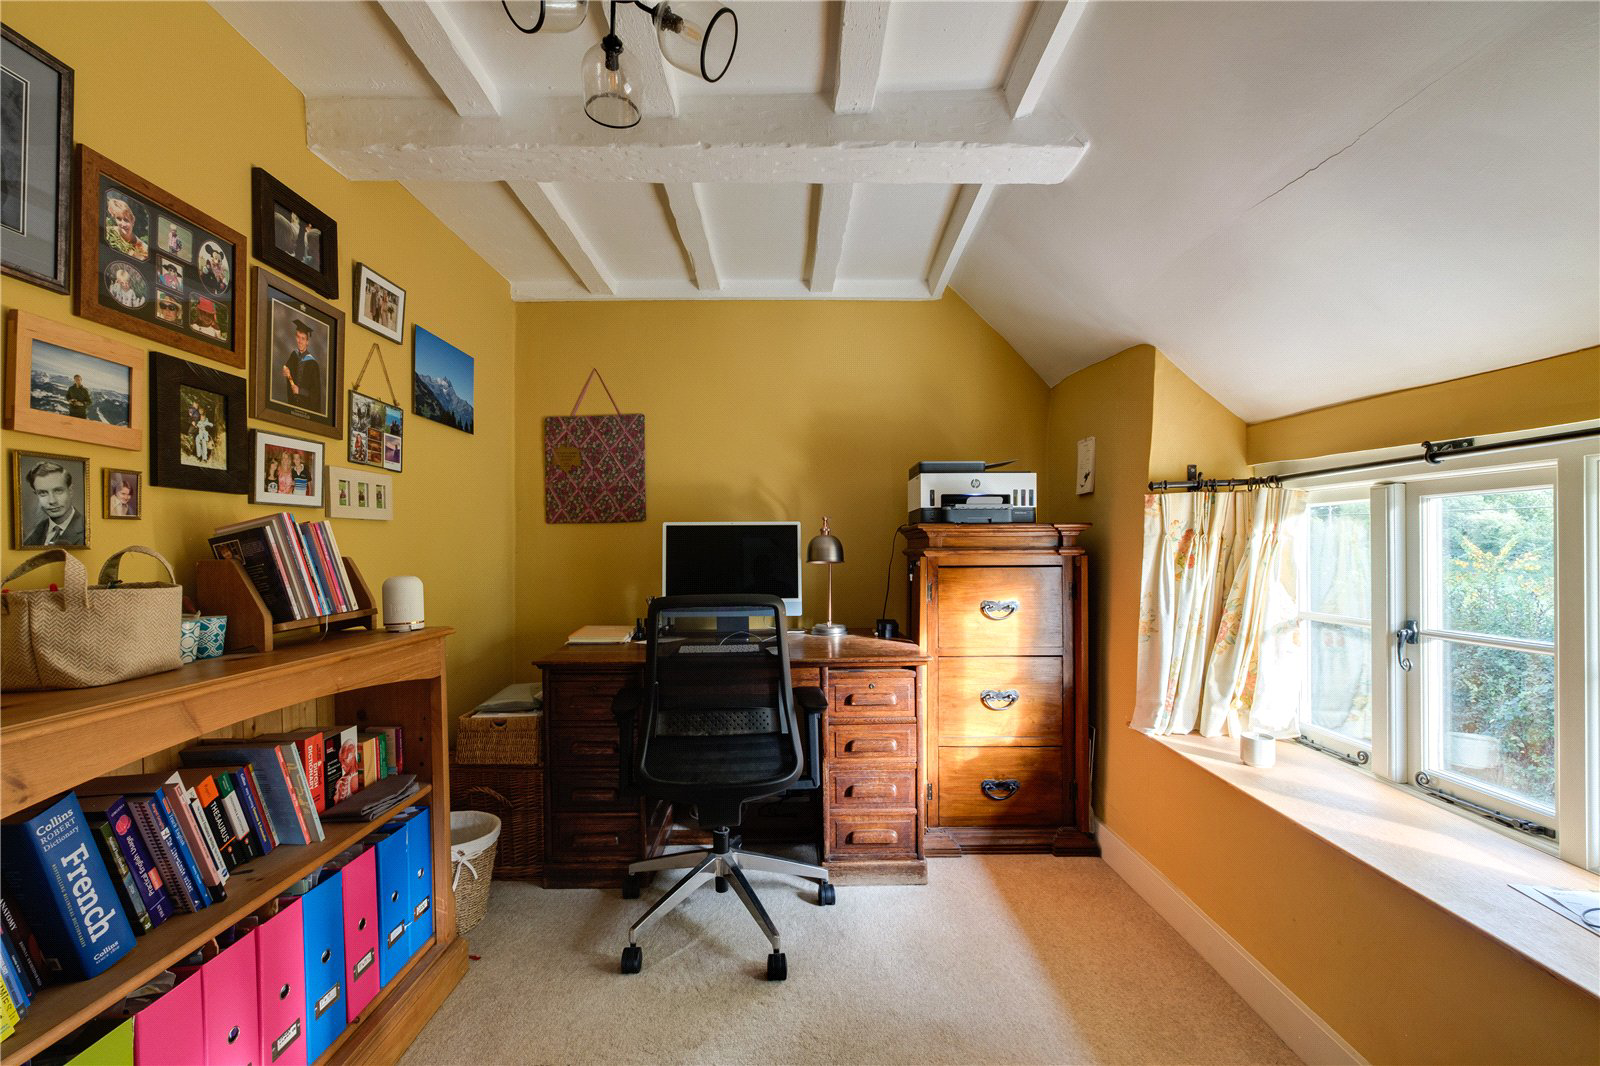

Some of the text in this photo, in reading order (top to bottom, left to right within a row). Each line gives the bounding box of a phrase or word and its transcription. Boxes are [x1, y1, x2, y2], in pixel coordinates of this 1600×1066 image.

[36, 808, 74, 836] Collins
[40, 817, 76, 845] ROBERT
[210, 801, 230, 842] THESAURUS
[43, 826, 80, 852] Dictionary
[126, 835, 138, 855] Usage
[134, 853, 146, 876] English
[61, 843, 116, 944] French
[94, 940, 119, 961] Collins
